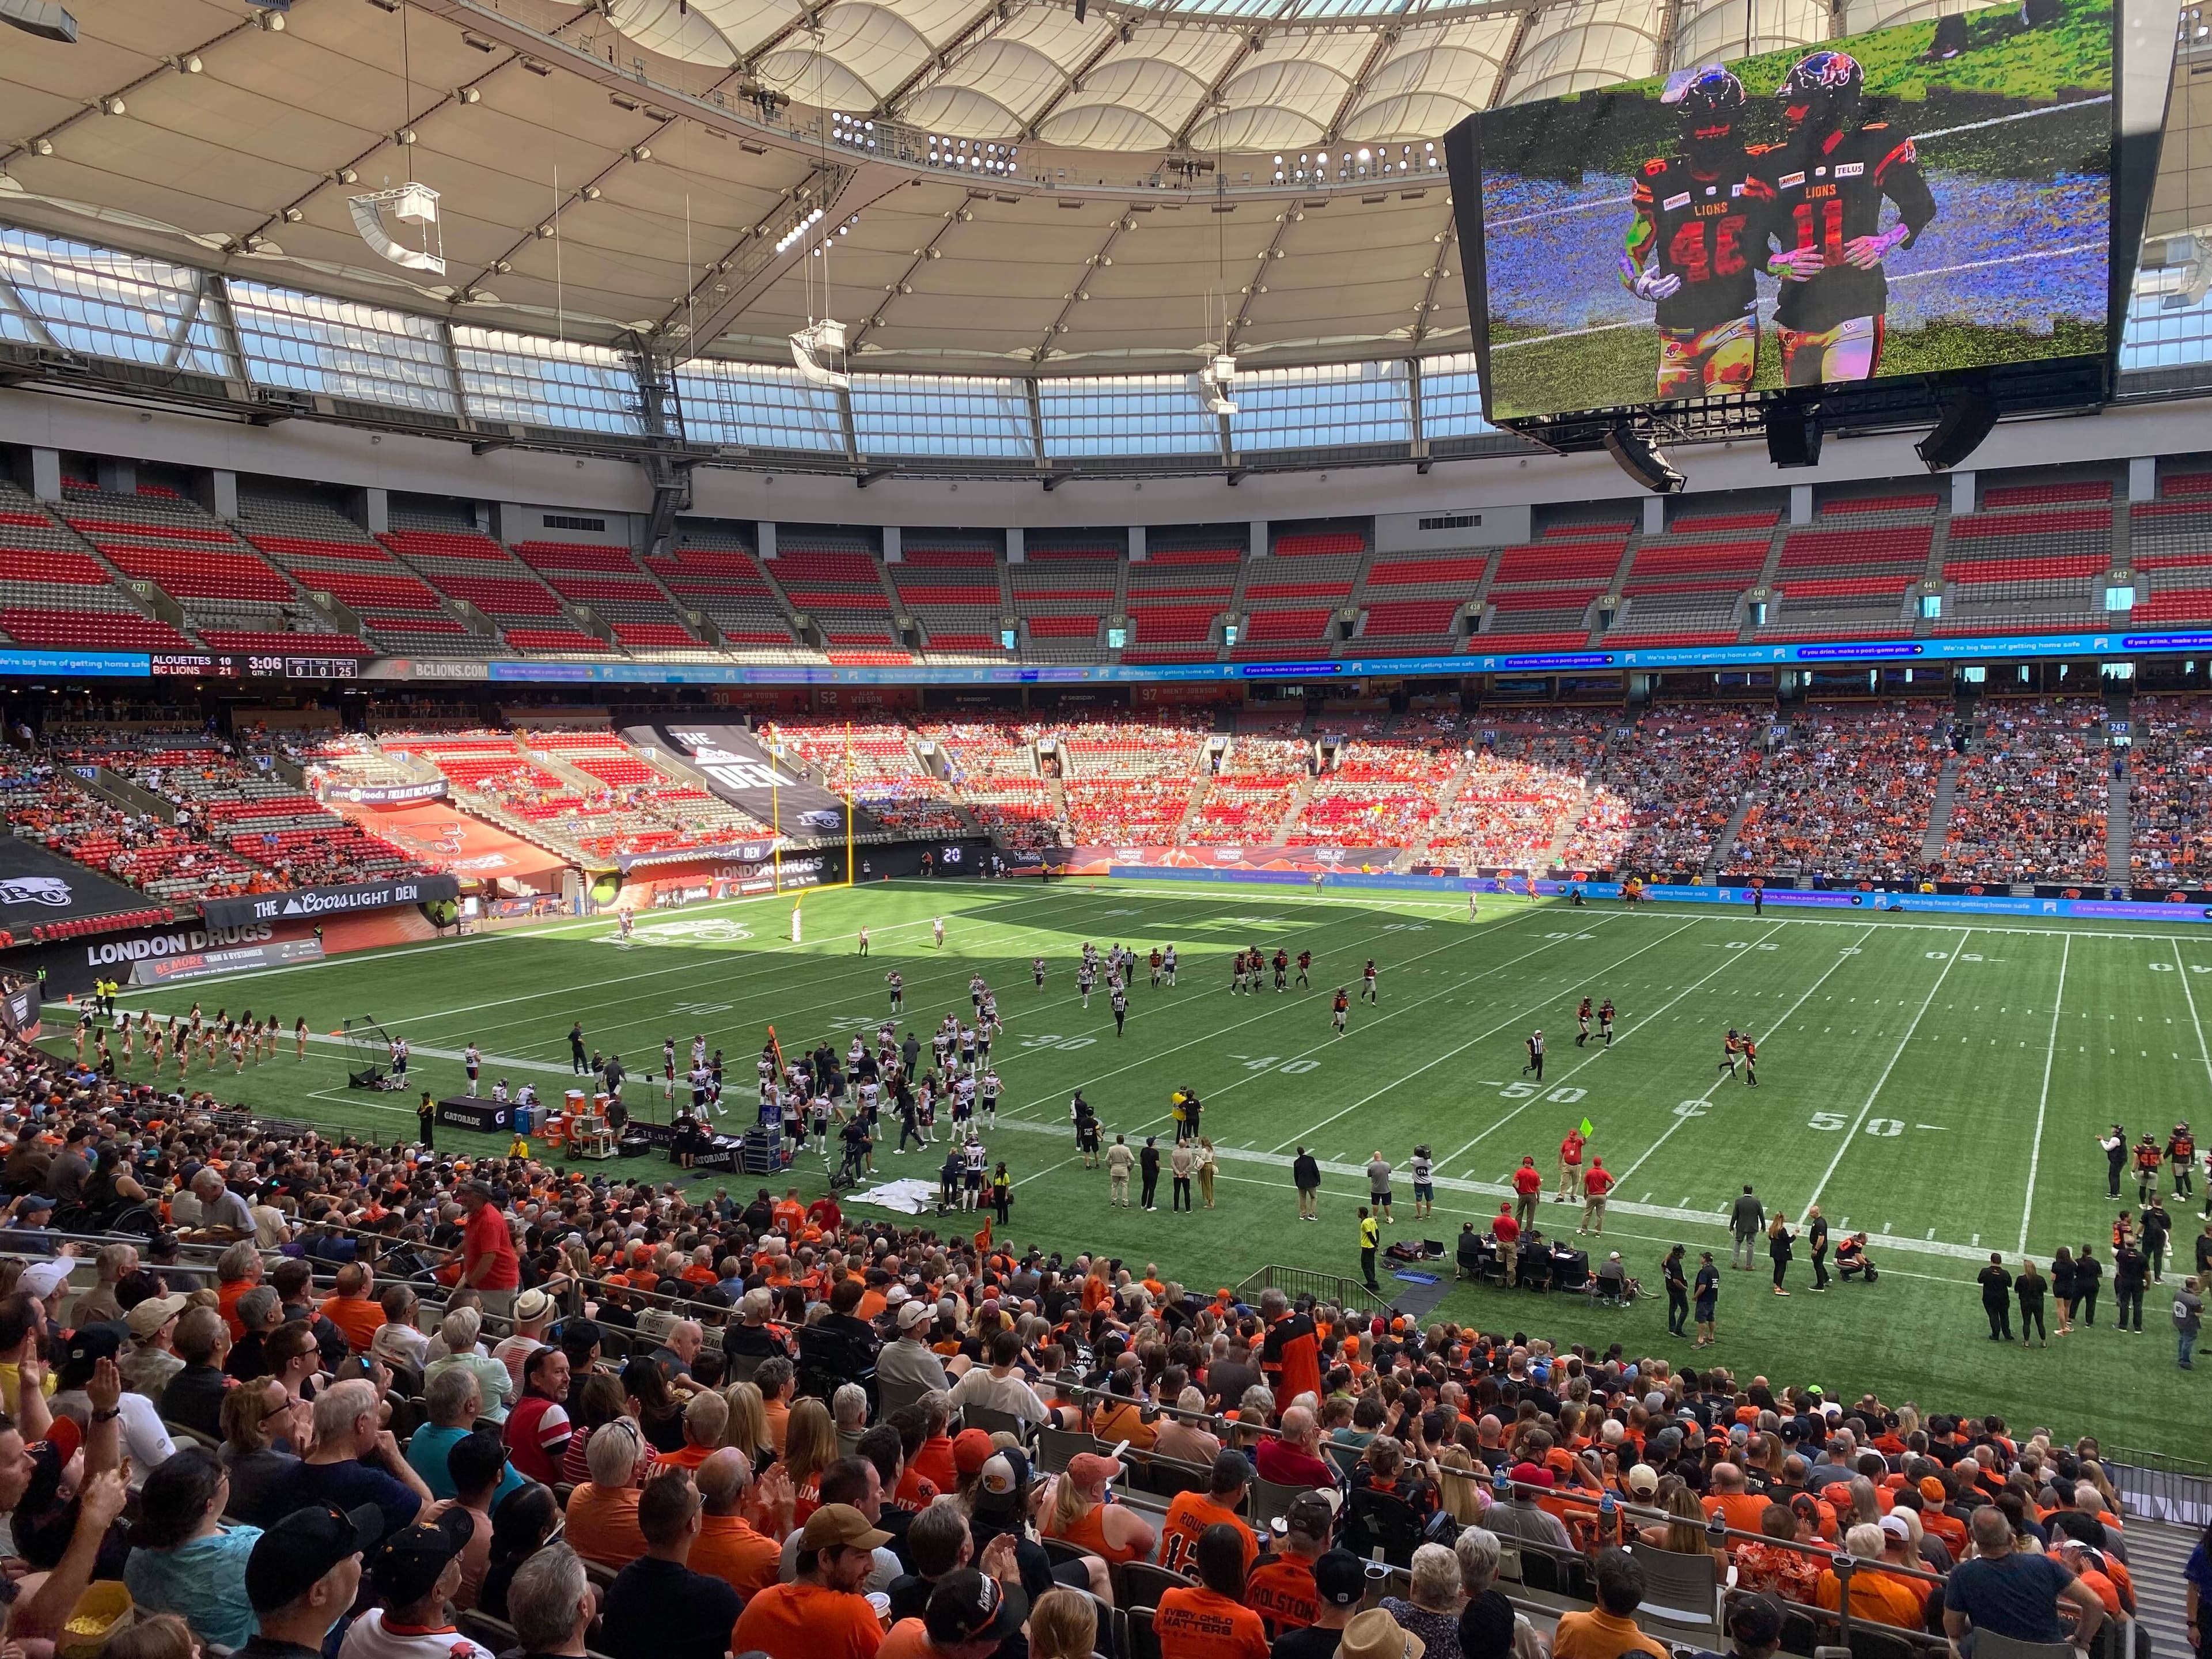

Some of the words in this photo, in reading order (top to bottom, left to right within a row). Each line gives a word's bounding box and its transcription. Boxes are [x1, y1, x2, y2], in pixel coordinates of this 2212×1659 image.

[1836, 165, 1862, 175] TELUS
[1806, 184, 1836, 199] LIONS
[1694, 201, 1728, 217] LIONS
[1793, 199, 1842, 268] 11
[2112, 571, 2127, 579] 442
[131, 584, 145, 592] 427
[2008, 643, 2036, 651] getting
[22, 659, 36, 667] big
[70, 660, 103, 669] getting
[153, 656, 211, 665] ALOUETTES
[219, 657, 231, 665] 10
[248, 656, 282, 669] 3:06
[153, 665, 167, 674] BC
[171, 666, 200, 675] LIONS
[219, 667, 231, 675] 21
[296, 666, 302, 676] 0
[320, 667, 326, 676] 0
[339, 667, 351, 676] 25
[416, 664, 488, 677] BCLIONS.COM
[820, 692, 837, 703] 52
[2111, 723, 2126, 731] 242
[669, 733, 717, 746] THE
[77, 768, 92, 778] 226
[700, 764, 797, 790] DEN
[362, 790, 385, 799] foods
[387, 790, 404, 800] FIELD
[405, 789, 413, 798] AT
[413, 787, 423, 797] BC
[423, 783, 442, 795] PLACE
[744, 847, 760, 858] DEN
[944, 848, 960, 862] 20
[714, 863, 775, 881] LONDON
[778, 857, 824, 875] DRUGS
[254, 900, 278, 918] THE
[301, 893, 349, 914] Coors
[349, 890, 389, 907] LIGHT
[395, 885, 418, 902] DEN
[1960, 900, 1988, 908] getting
[88, 934, 186, 967] LONDON
[190, 921, 273, 950] DRUGS
[155, 963, 168, 974] BE
[172, 956, 203, 969] MORE
[204, 953, 222, 963] THAN
[229, 949, 263, 960] BYSTANDER
[217, 965, 248, 973] Gender-Based
[1020, 1035, 1097, 1050] 30
[1241, 1056, 1321, 1073] 40
[984, 1085, 995, 1094] 18
[1499, 1082, 1588, 1104] 50
[866, 1092, 877, 1101] 60
[444, 1111, 481, 1126] GATORADE
[495, 1111, 505, 1124] G
[817, 1108, 822, 1117] 3
[1808, 1111, 1906, 1137] 50
[694, 1152, 730, 1165] ATORADE
[967, 1155, 980, 1167] 14
[779, 1217, 788, 1232] 9
[645, 1317, 664, 1330] KNIGHT
[1253, 1586, 1315, 1620] ROLSTON
[1165, 1607, 1196, 1619] EVERY
[1199, 1613, 1233, 1626] CHILD
[1163, 1615, 1232, 1636] MATTERS
